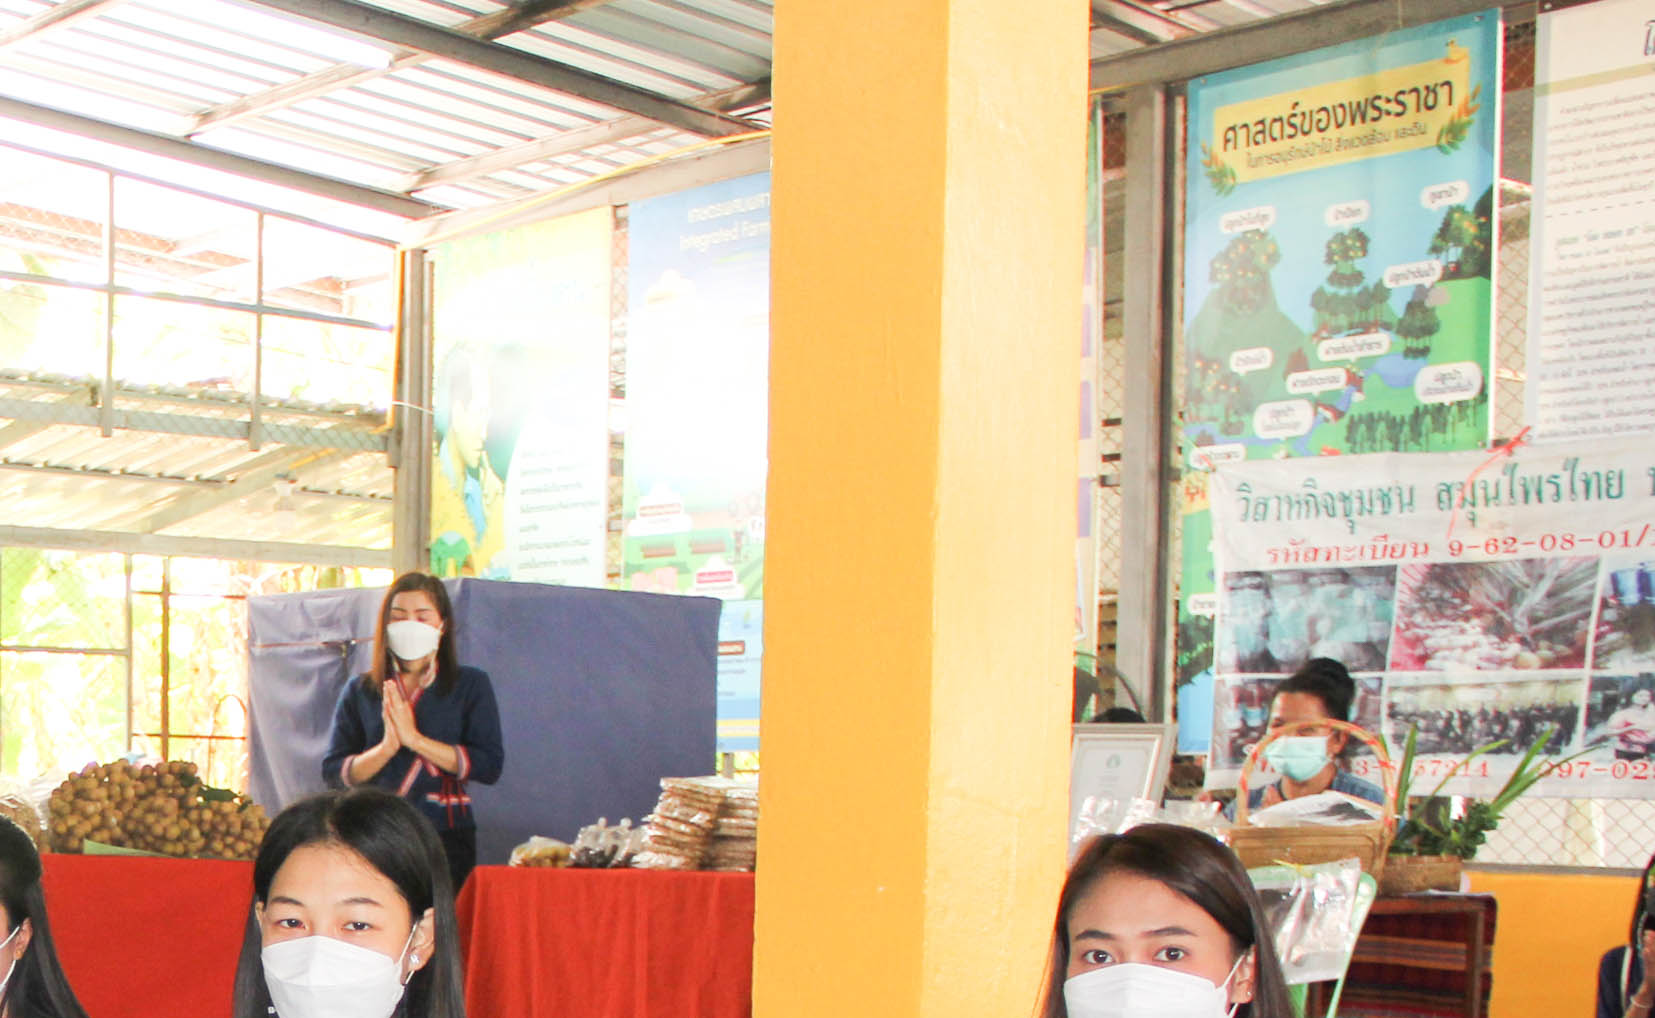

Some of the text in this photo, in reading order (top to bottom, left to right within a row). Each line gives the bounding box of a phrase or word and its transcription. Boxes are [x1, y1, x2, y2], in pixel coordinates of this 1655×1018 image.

[1222, 80, 1454, 153] ศาสตร์ของพระราชา
[1235, 477, 1417, 536] วิสาหกิจชุมชน
[1436, 457, 1626, 528] สมุนไพรไทย
[1266, 523, 1655, 565] รหัสทะเบียน 9-62-08-01/
